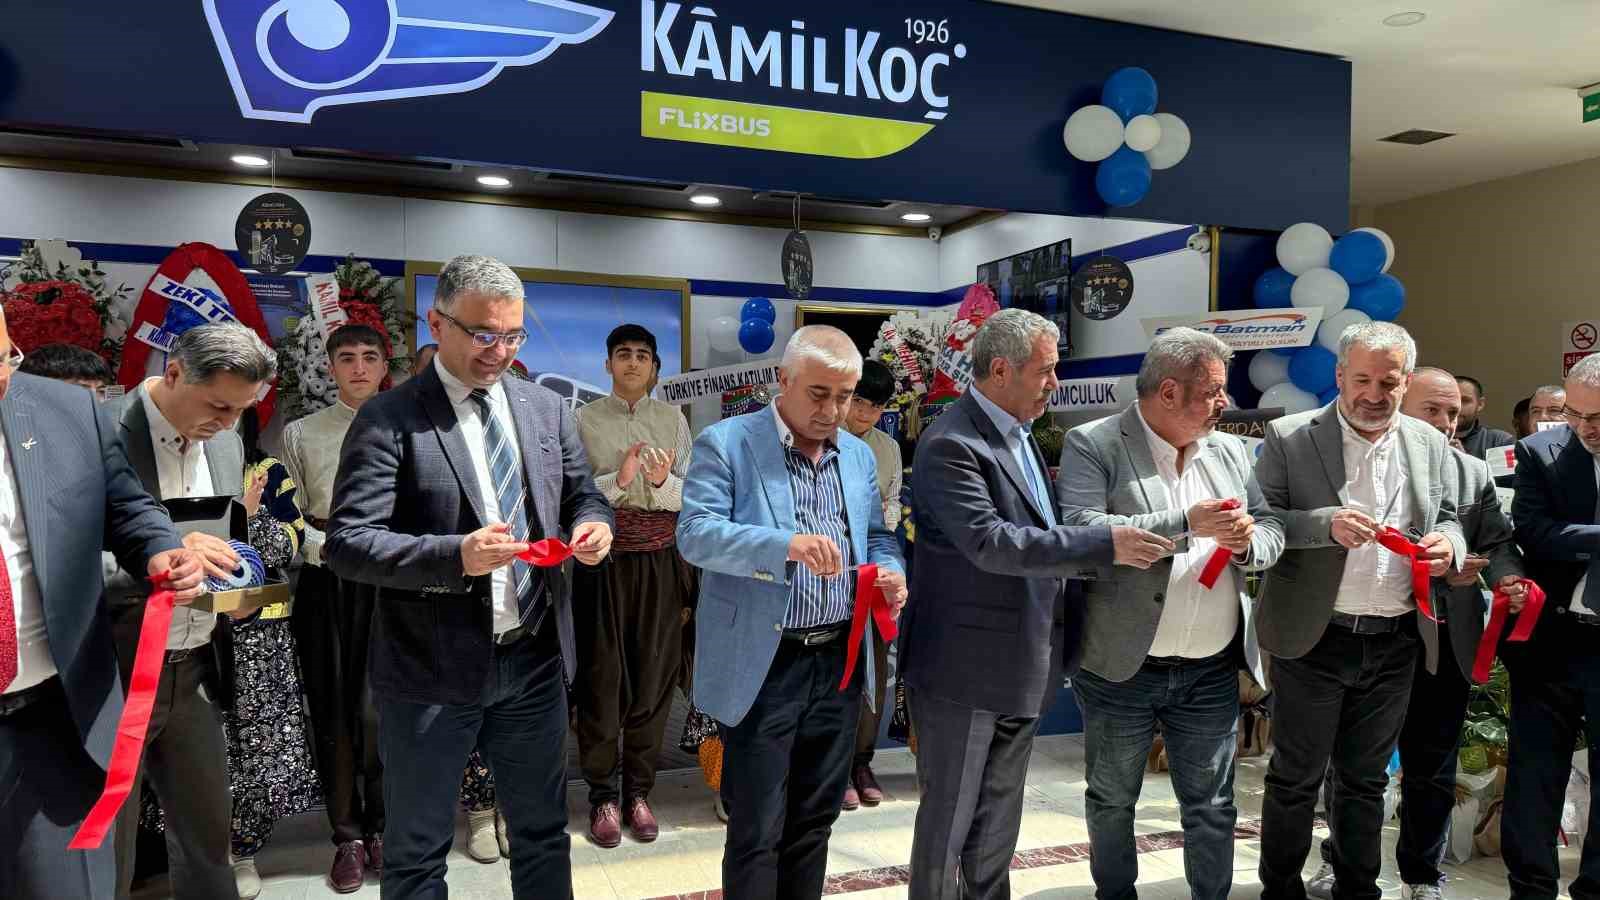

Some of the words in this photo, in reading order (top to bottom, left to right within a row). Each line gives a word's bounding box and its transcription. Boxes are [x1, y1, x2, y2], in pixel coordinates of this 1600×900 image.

[904, 18, 949, 44] 1926
[1213, 324, 1306, 334] Batman
[663, 377, 704, 402] TÜRKİYE
[704, 373, 737, 395] FİNANS
[737, 366, 773, 389] KATILIM
[1050, 383, 1117, 407] UMCULUK
